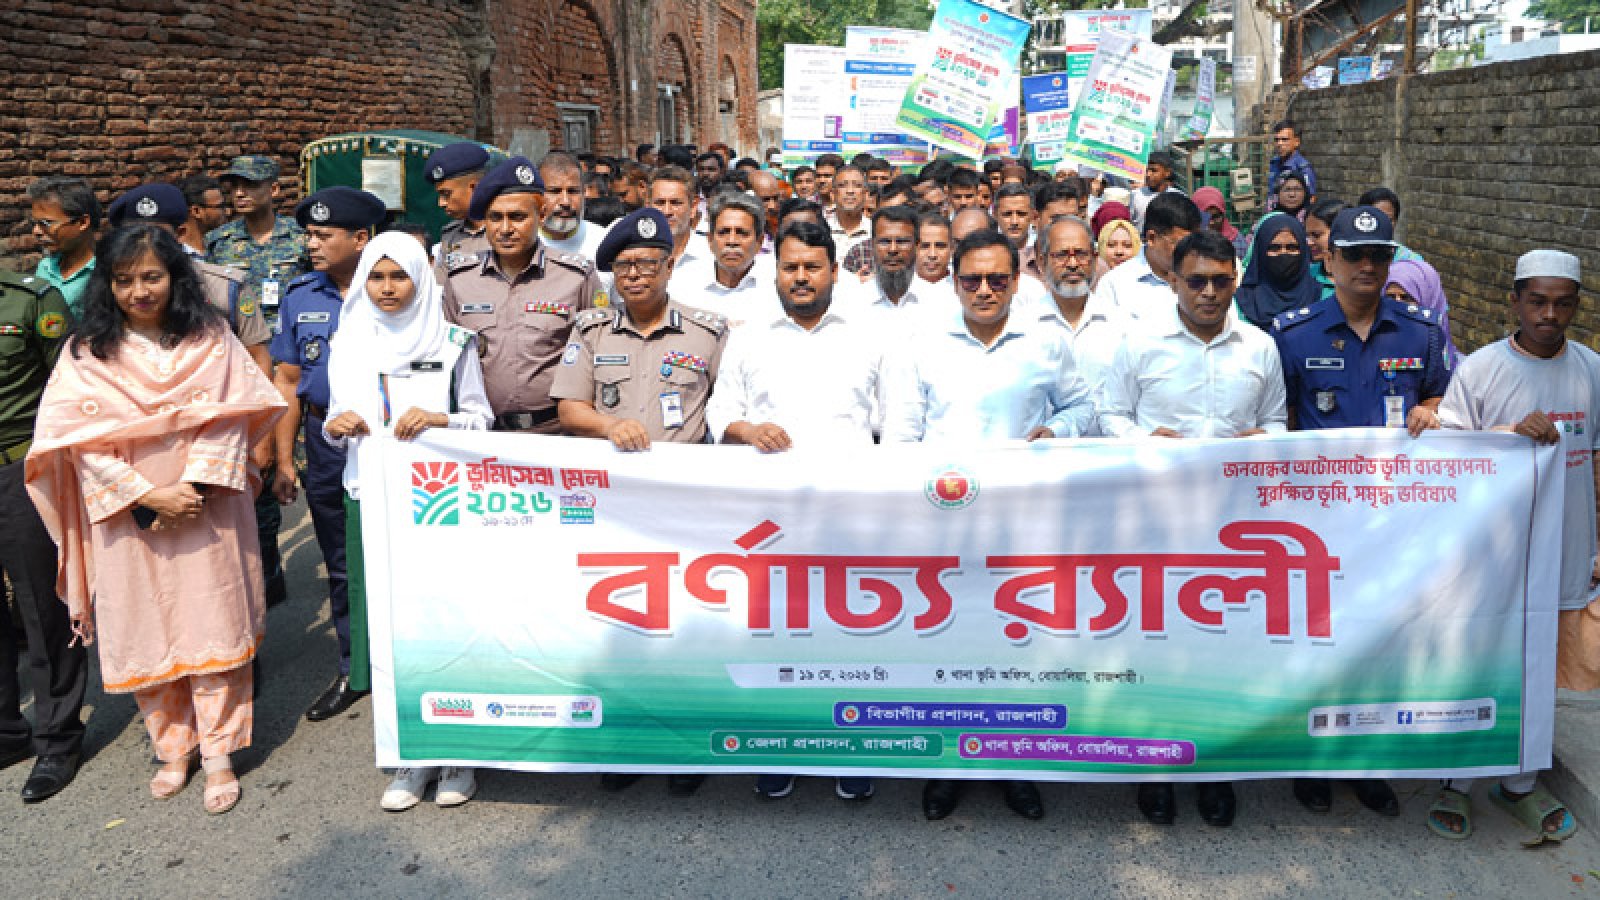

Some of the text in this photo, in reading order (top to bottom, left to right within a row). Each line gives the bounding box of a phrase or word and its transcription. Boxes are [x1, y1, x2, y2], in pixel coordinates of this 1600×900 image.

[465, 456, 610, 492] ভূমিসেবা মেলা
[1222, 461, 1291, 478] জনবান্ধব
[1293, 453, 1379, 476] অটোমেটেড
[1380, 453, 1411, 482] ভূমি
[465, 491, 553, 516] ২০২৬
[1256, 480, 1315, 508] সুরক্ষিত
[1317, 480, 1352, 508] ভূমি,
[1353, 485, 1395, 509] সমৃদ্ধ
[577, 519, 1341, 641] বর্ণাঢ্য র‍্যালী
[996, 707, 1059, 723] রাজশাহী
[862, 735, 929, 752] রাজশাহী
